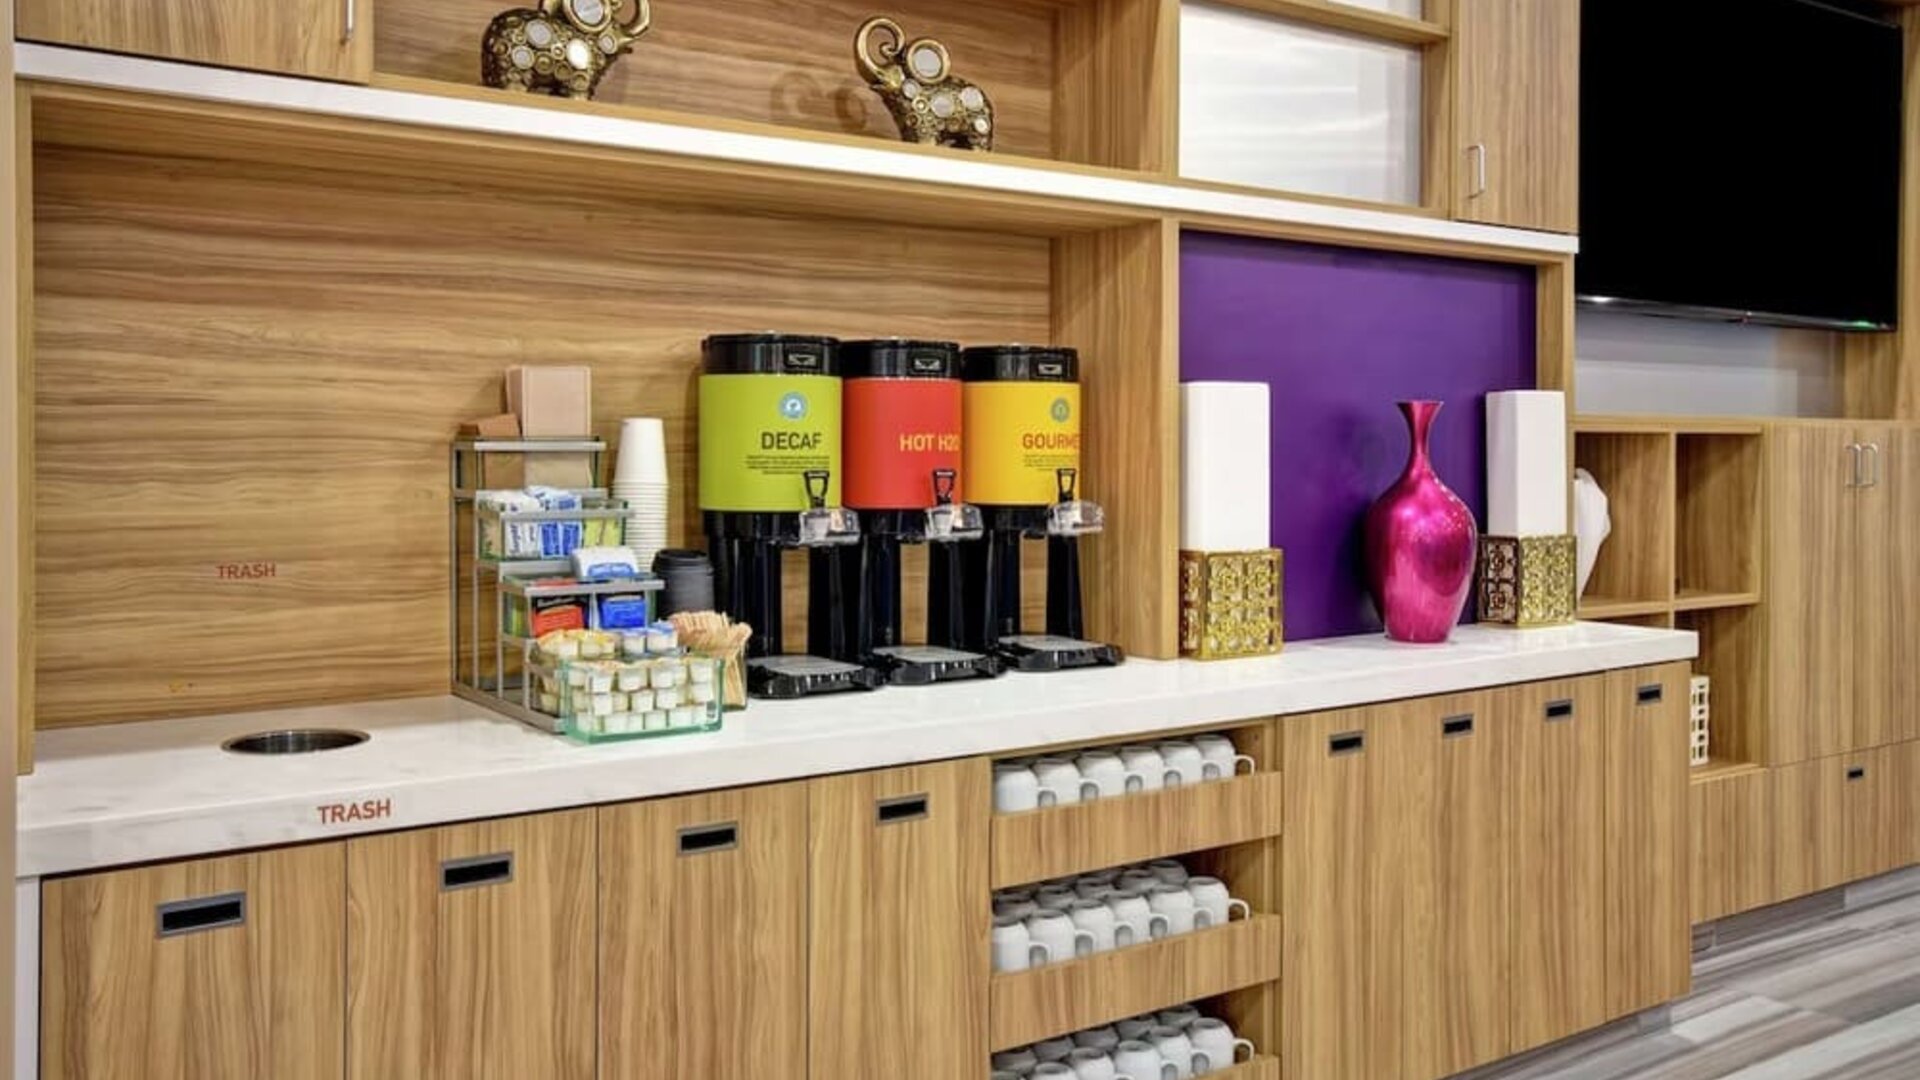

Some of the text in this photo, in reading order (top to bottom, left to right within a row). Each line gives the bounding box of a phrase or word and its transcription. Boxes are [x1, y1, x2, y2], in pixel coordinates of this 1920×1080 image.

[761, 431, 822, 450] DECAF
[899, 433, 934, 452] HOT
[215, 560, 276, 579] TRASH
[317, 798, 391, 824] TRASH
